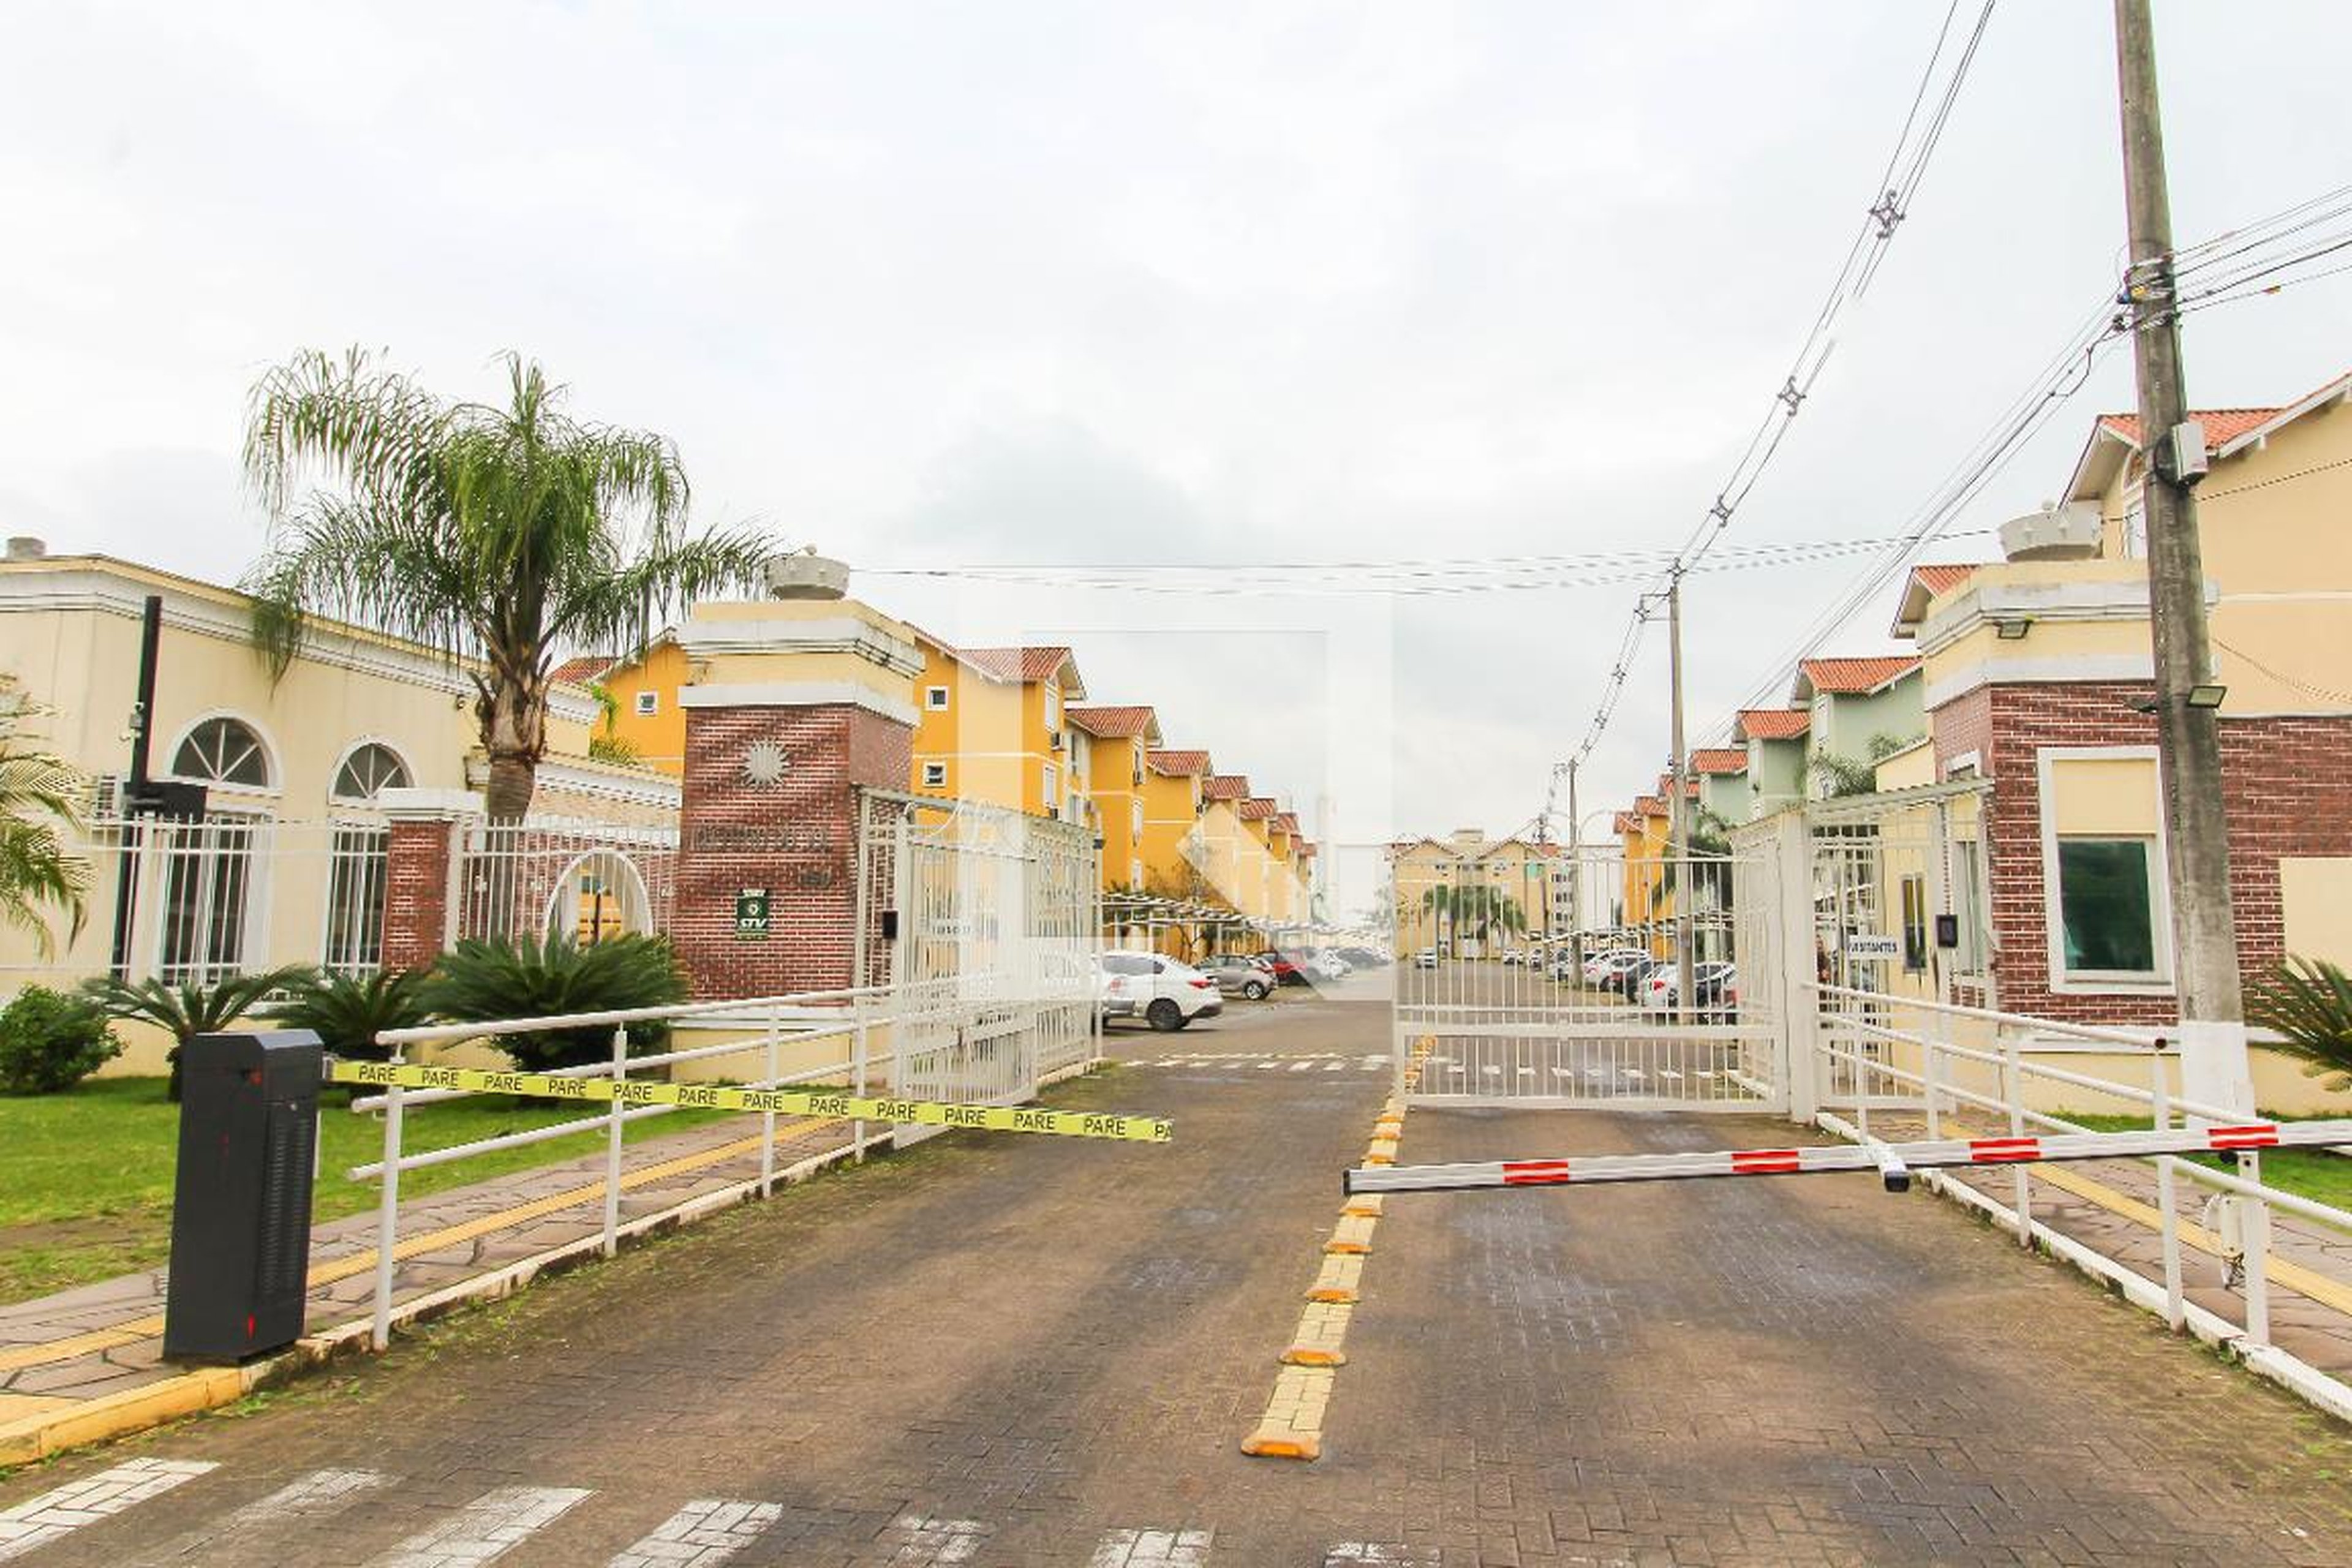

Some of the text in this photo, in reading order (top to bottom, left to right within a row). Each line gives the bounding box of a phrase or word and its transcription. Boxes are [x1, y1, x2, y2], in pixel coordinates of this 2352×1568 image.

[358, 1065, 397, 1082] PARE
[421, 1069, 459, 1086] PARE
[484, 1073, 523, 1091] PARE
[548, 1079, 587, 1096] PARE
[613, 1083, 652, 1101] PARE
[677, 1087, 717, 1105] PARE
[743, 1092, 783, 1110] PARE
[809, 1098, 849, 1115] PARE
[876, 1102, 917, 1120] PARE
[944, 1107, 987, 1126] PARE
[1014, 1112, 1056, 1130] PARE
[1083, 1118, 1126, 1136] PARE
